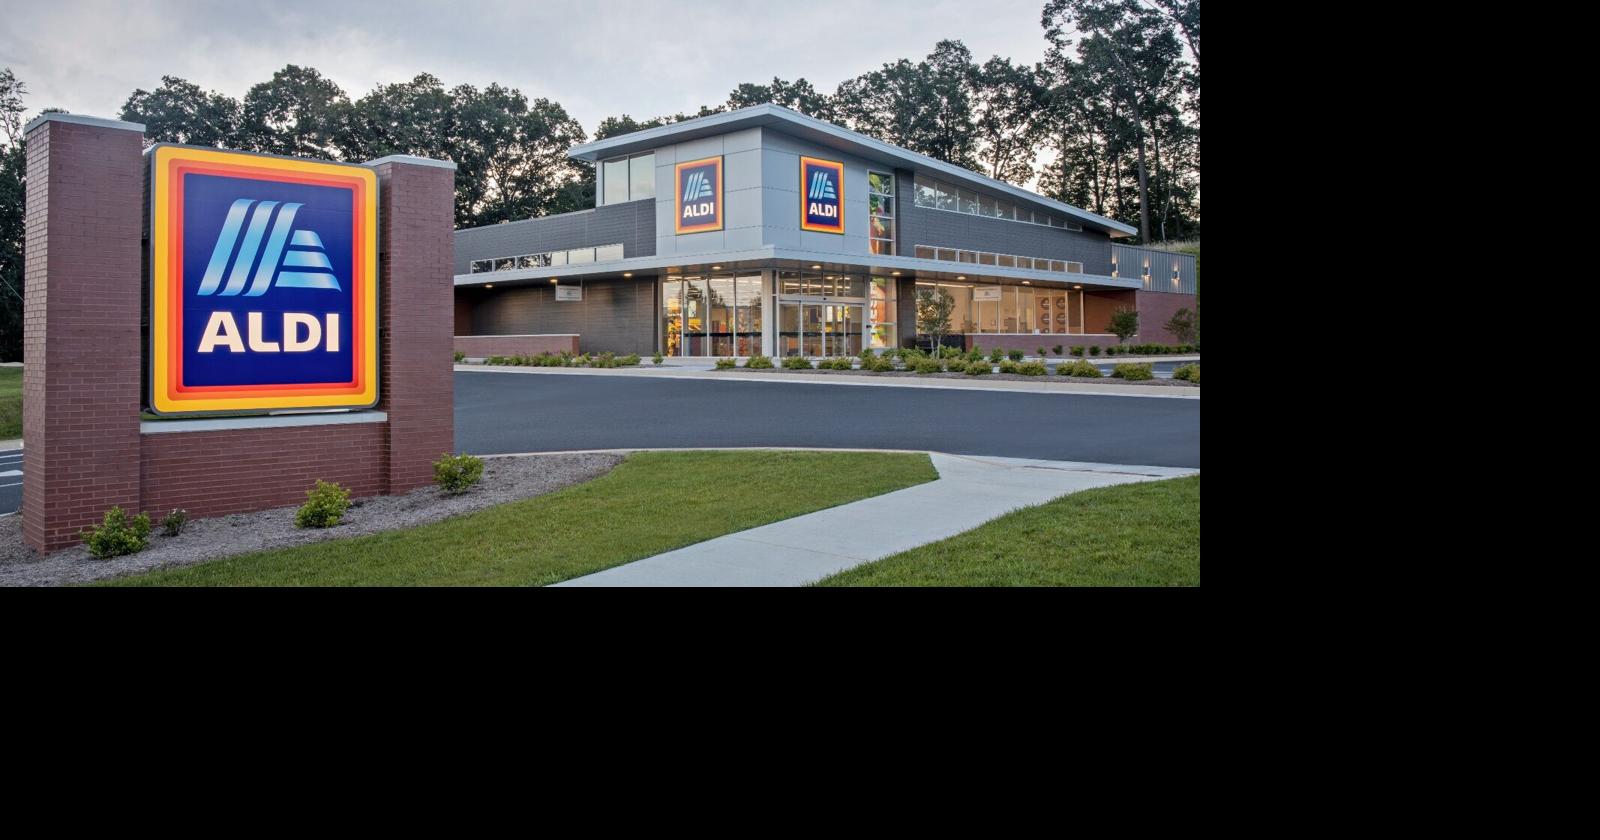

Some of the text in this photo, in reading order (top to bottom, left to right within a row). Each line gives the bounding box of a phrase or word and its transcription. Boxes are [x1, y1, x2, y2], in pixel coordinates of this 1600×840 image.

[683, 201, 714, 218] ALDI
[809, 202, 837, 218] ALDI
[198, 312, 339, 352] ALDI
